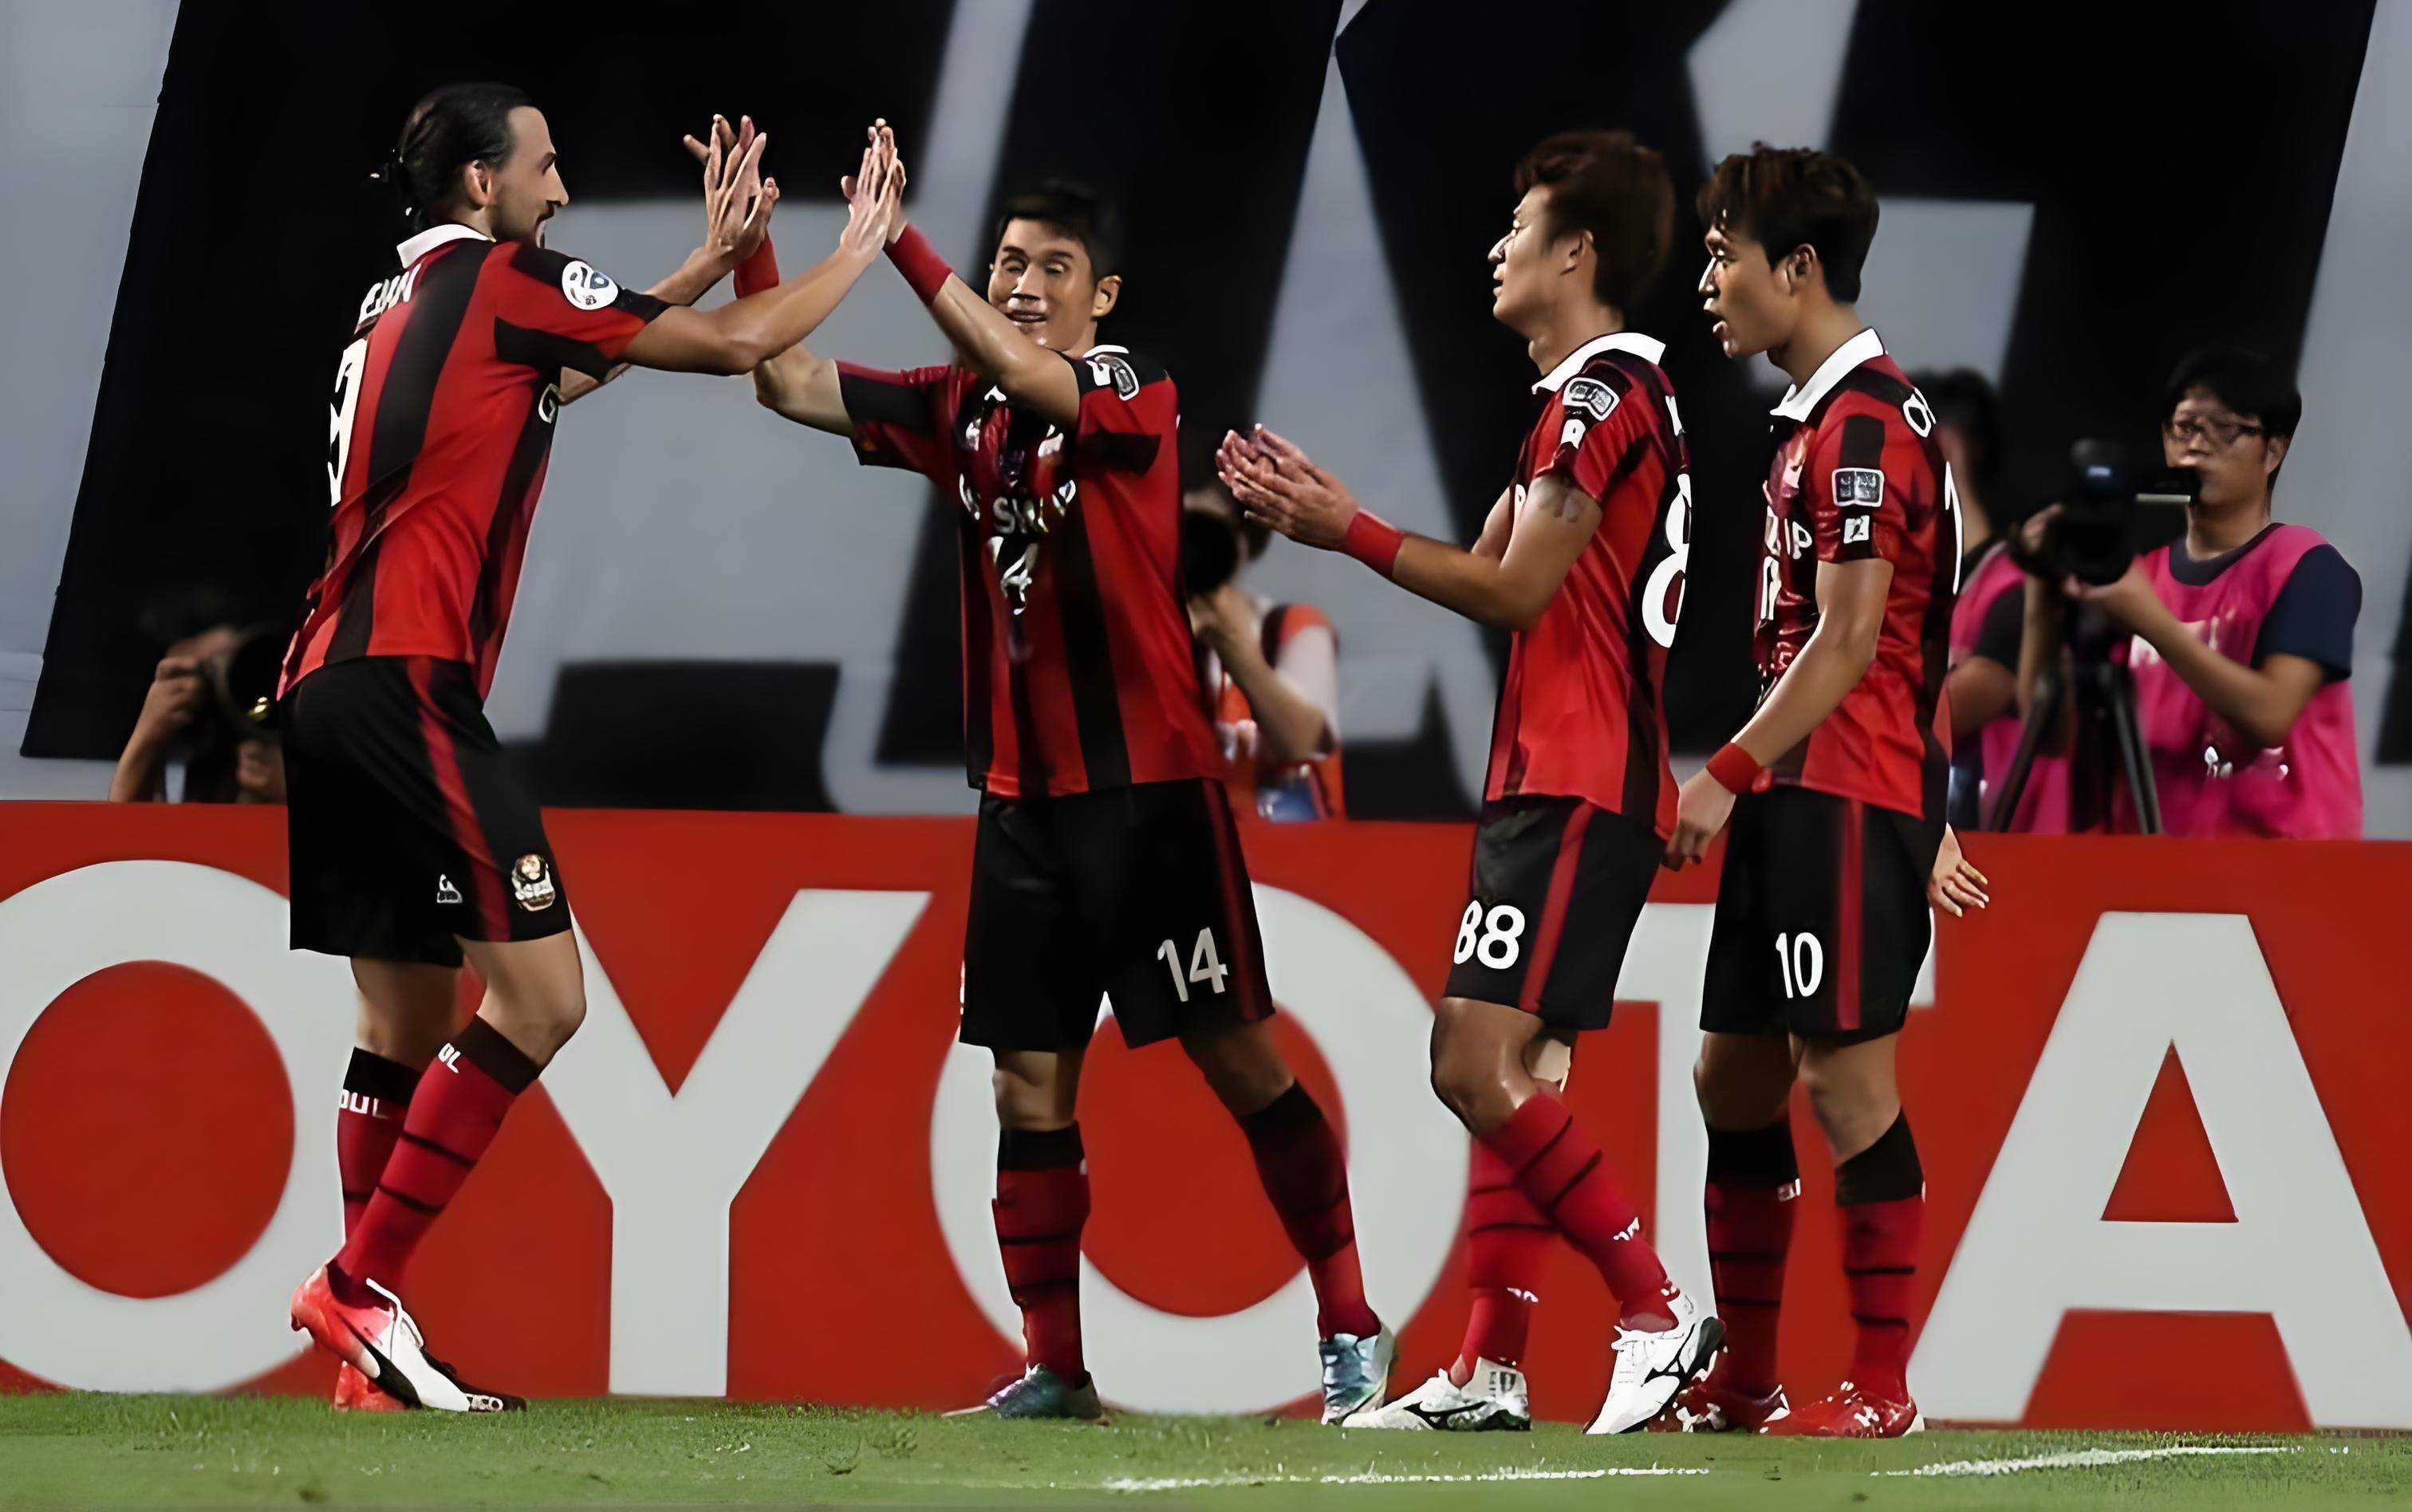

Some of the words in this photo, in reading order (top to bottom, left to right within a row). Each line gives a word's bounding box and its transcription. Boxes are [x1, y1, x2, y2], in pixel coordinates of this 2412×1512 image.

[1157, 927, 1228, 1002] 14
[1453, 900, 1525, 970] 88
[1776, 931, 1823, 998] 10
